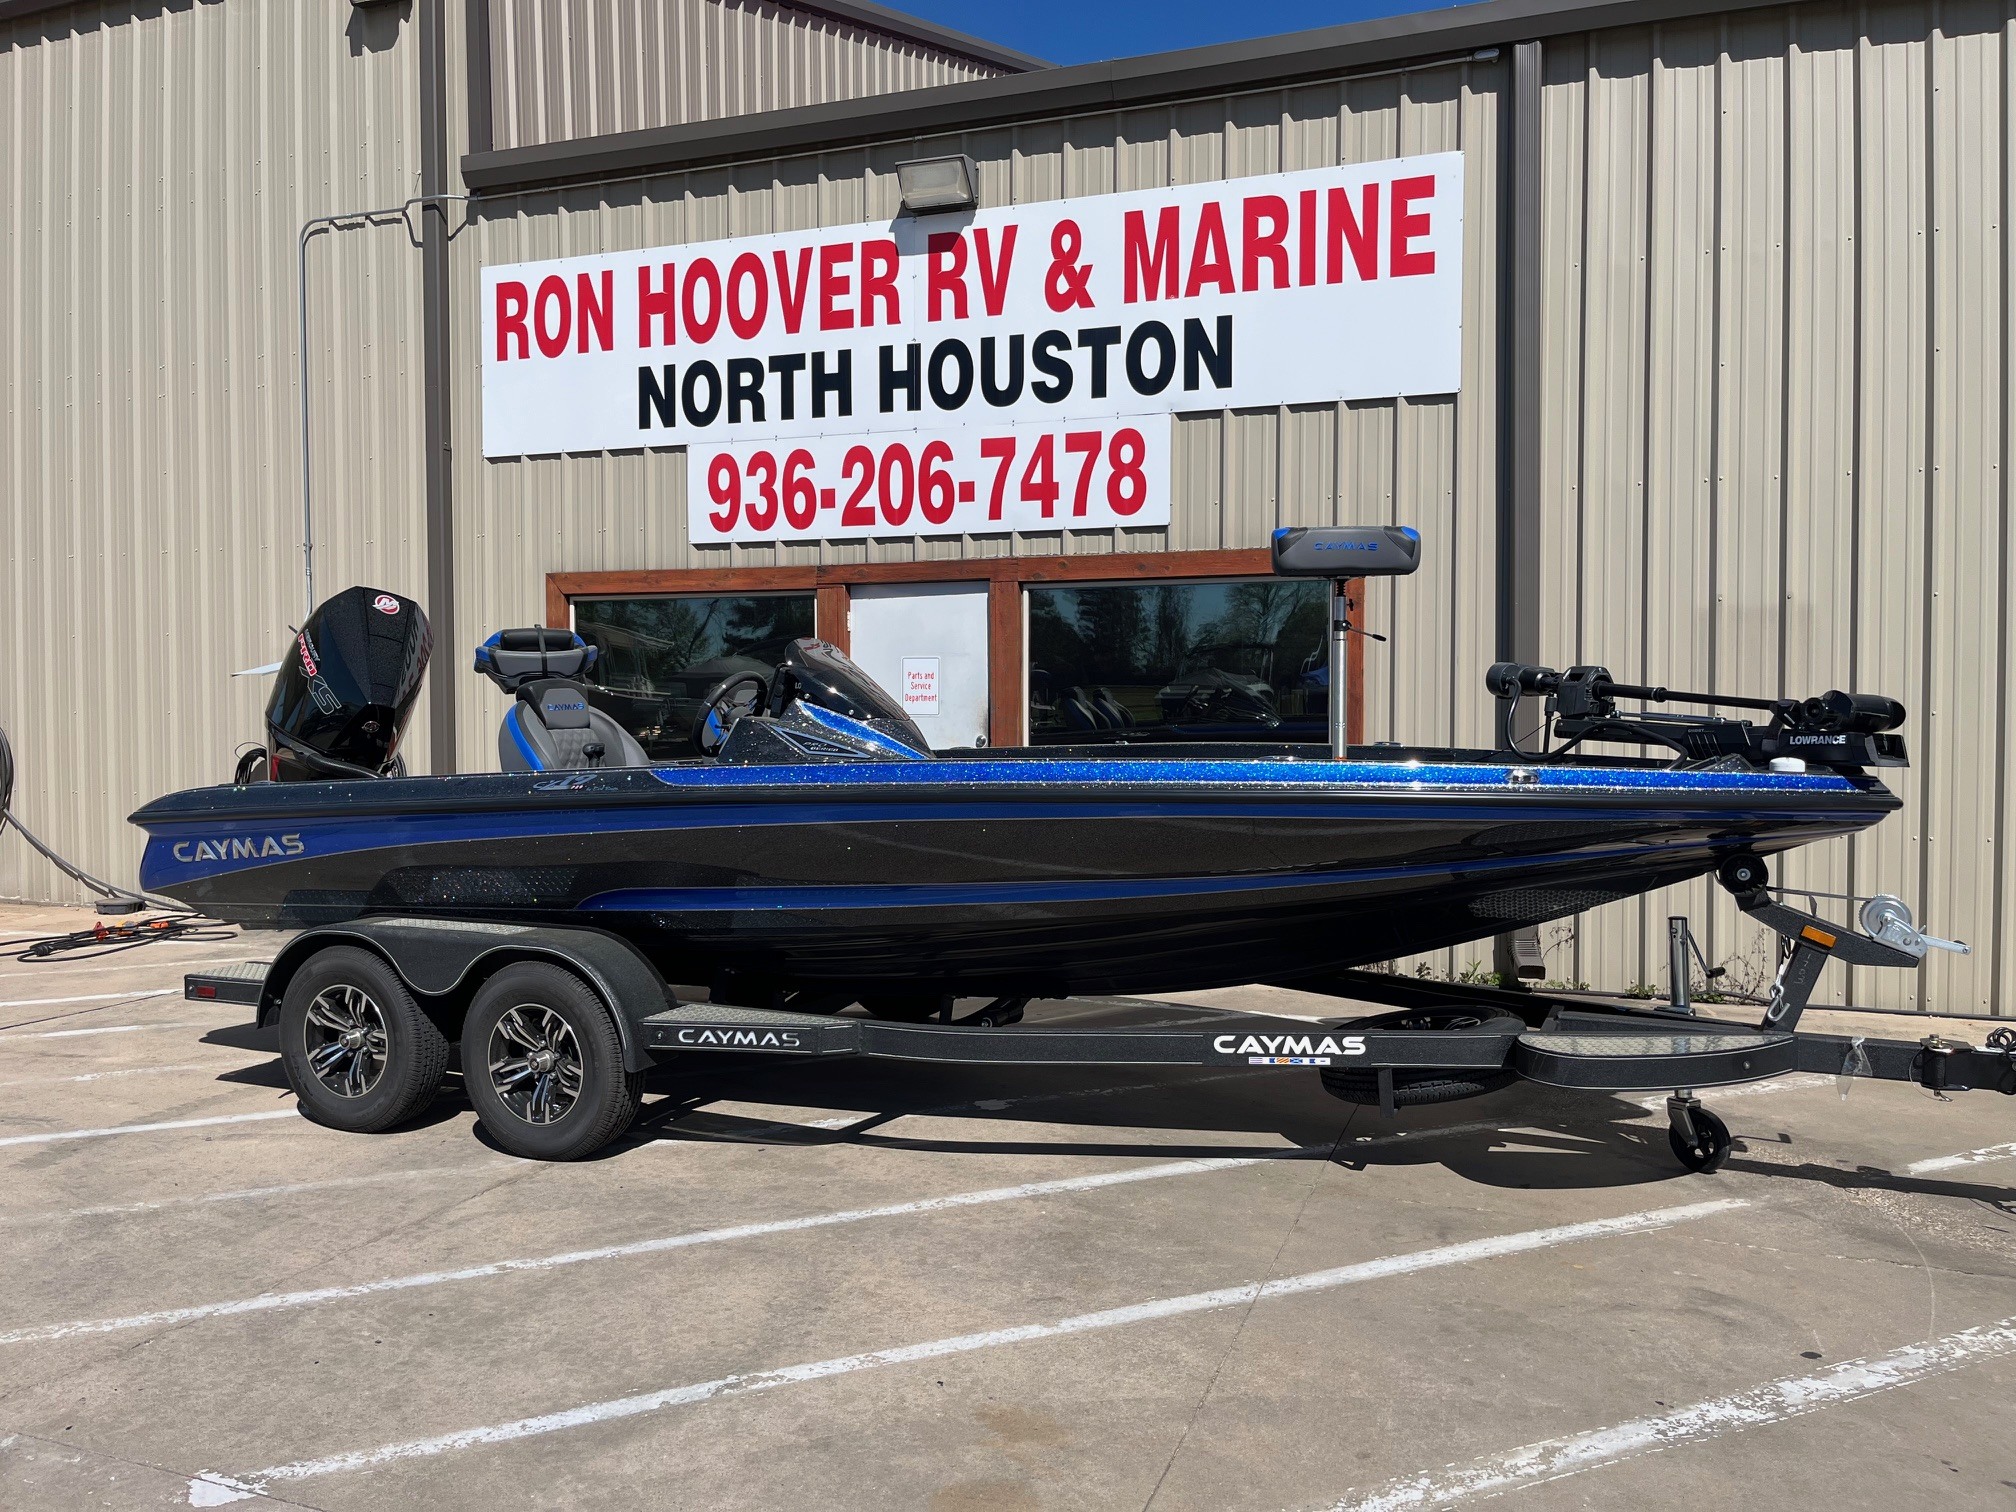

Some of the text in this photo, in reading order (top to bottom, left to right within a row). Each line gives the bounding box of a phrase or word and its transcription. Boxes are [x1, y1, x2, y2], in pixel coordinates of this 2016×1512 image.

[495, 174, 1436, 362] RON HOOVER RV & MARINE
[638, 314, 1233, 430] NORTH HOUSTON
[707, 427, 1147, 533] 936-206-7478
[1313, 541, 1379, 552] CAYMAS
[907, 671, 935, 680] Parts and
[910, 681, 931, 690] Service
[904, 693, 938, 703] Department
[547, 701, 585, 712] CAYMAS
[1789, 734, 1847, 745] LOWRANCE
[172, 832, 305, 863] CAYMAS
[677, 1028, 801, 1048] CAYMAS
[1212, 1034, 1367, 1057] CAYMAS
